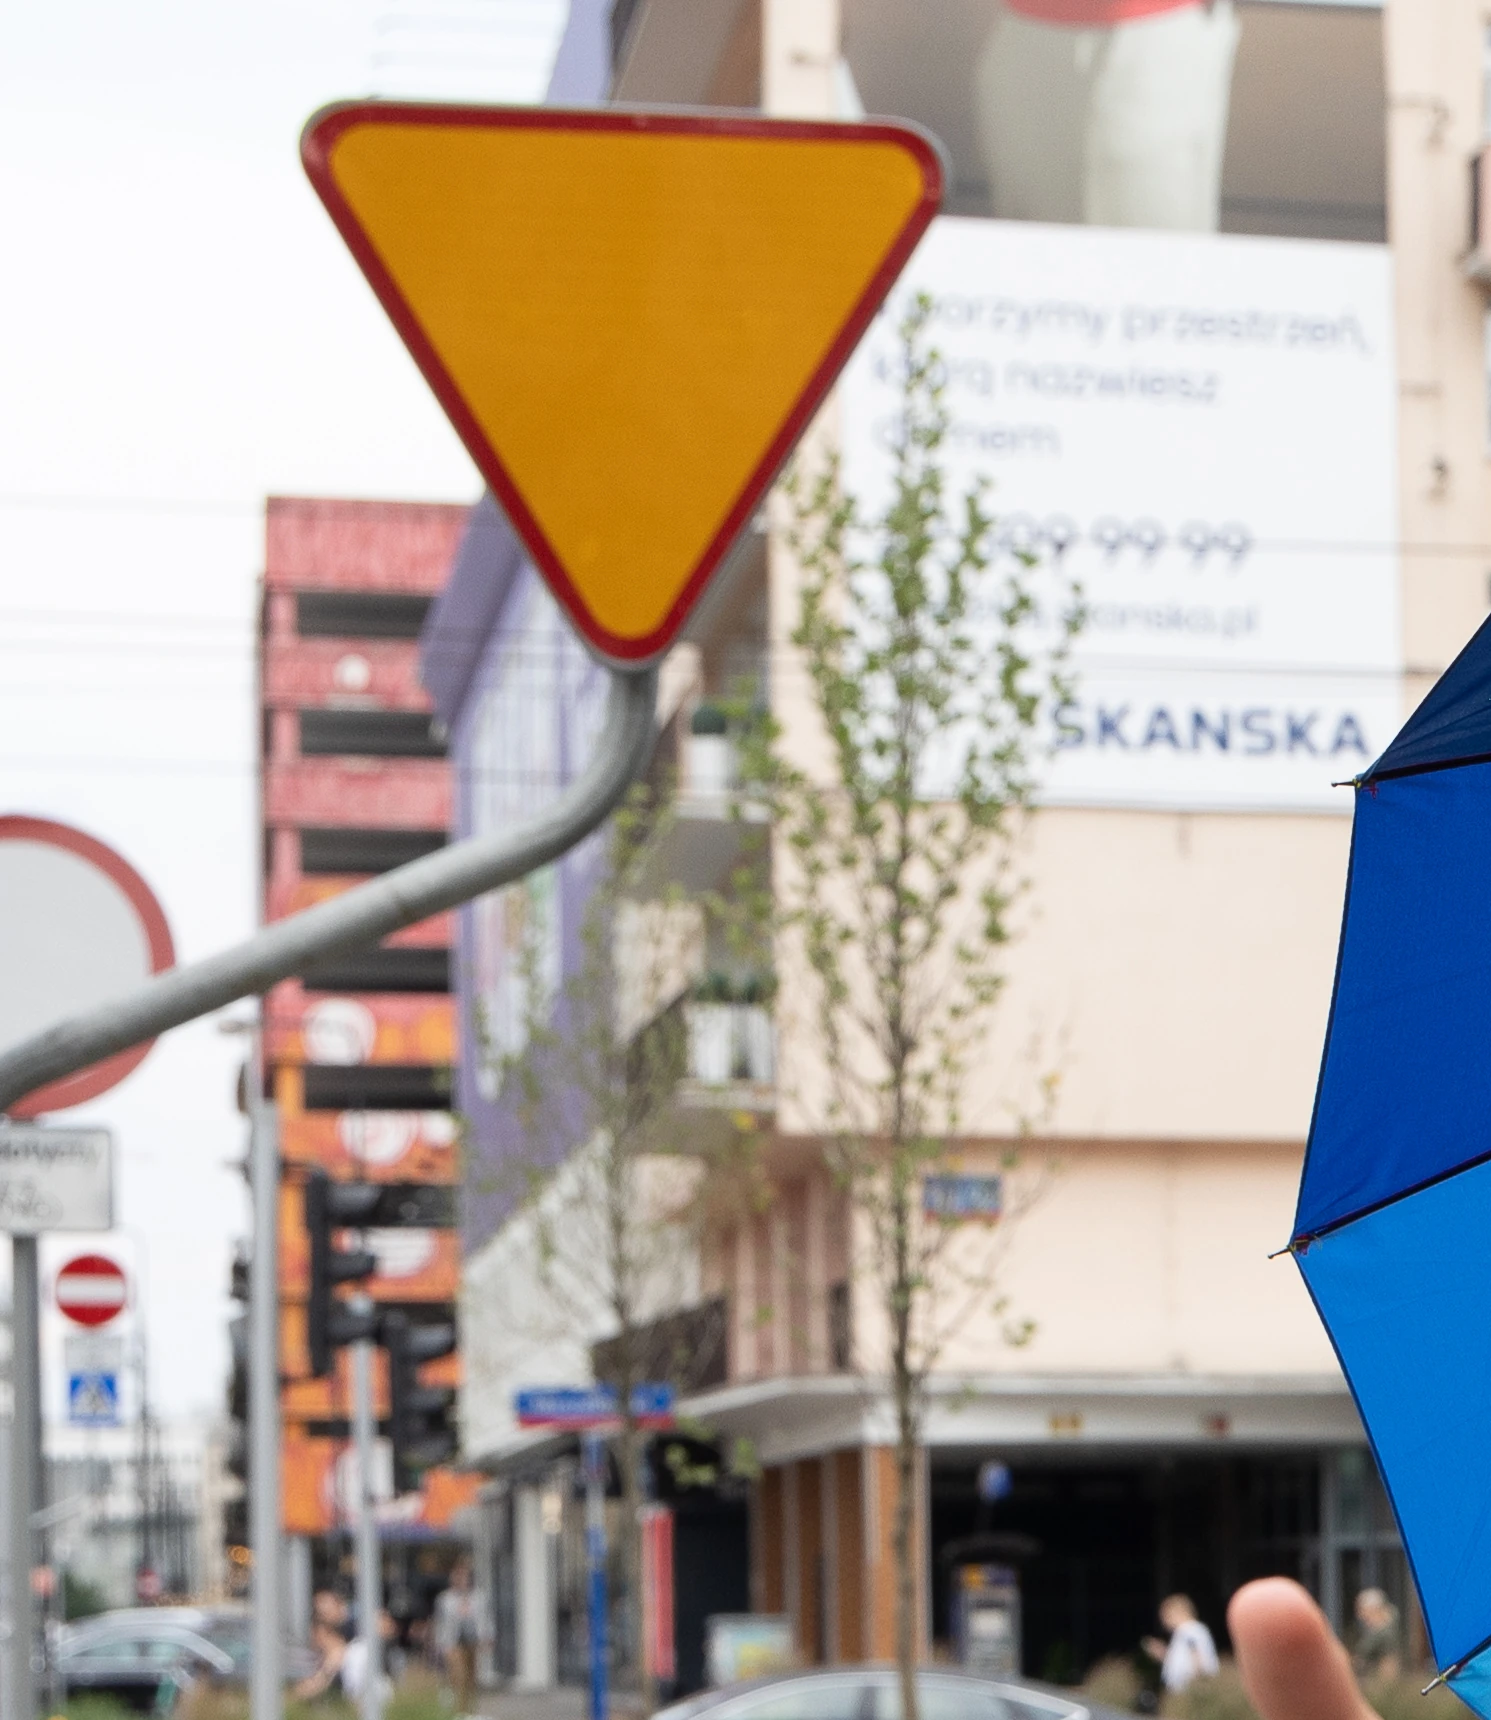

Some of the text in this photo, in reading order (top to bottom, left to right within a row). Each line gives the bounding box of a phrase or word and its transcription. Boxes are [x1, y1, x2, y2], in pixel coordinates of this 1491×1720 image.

[898, 294, 1112, 344] orzymy
[1003, 357, 1222, 408] nazwiesz
[871, 408, 1061, 459] dmem
[1089, 511, 1168, 571] 99
[1179, 515, 1254, 577] 99
[1050, 701, 1372, 759] SKANSKA
